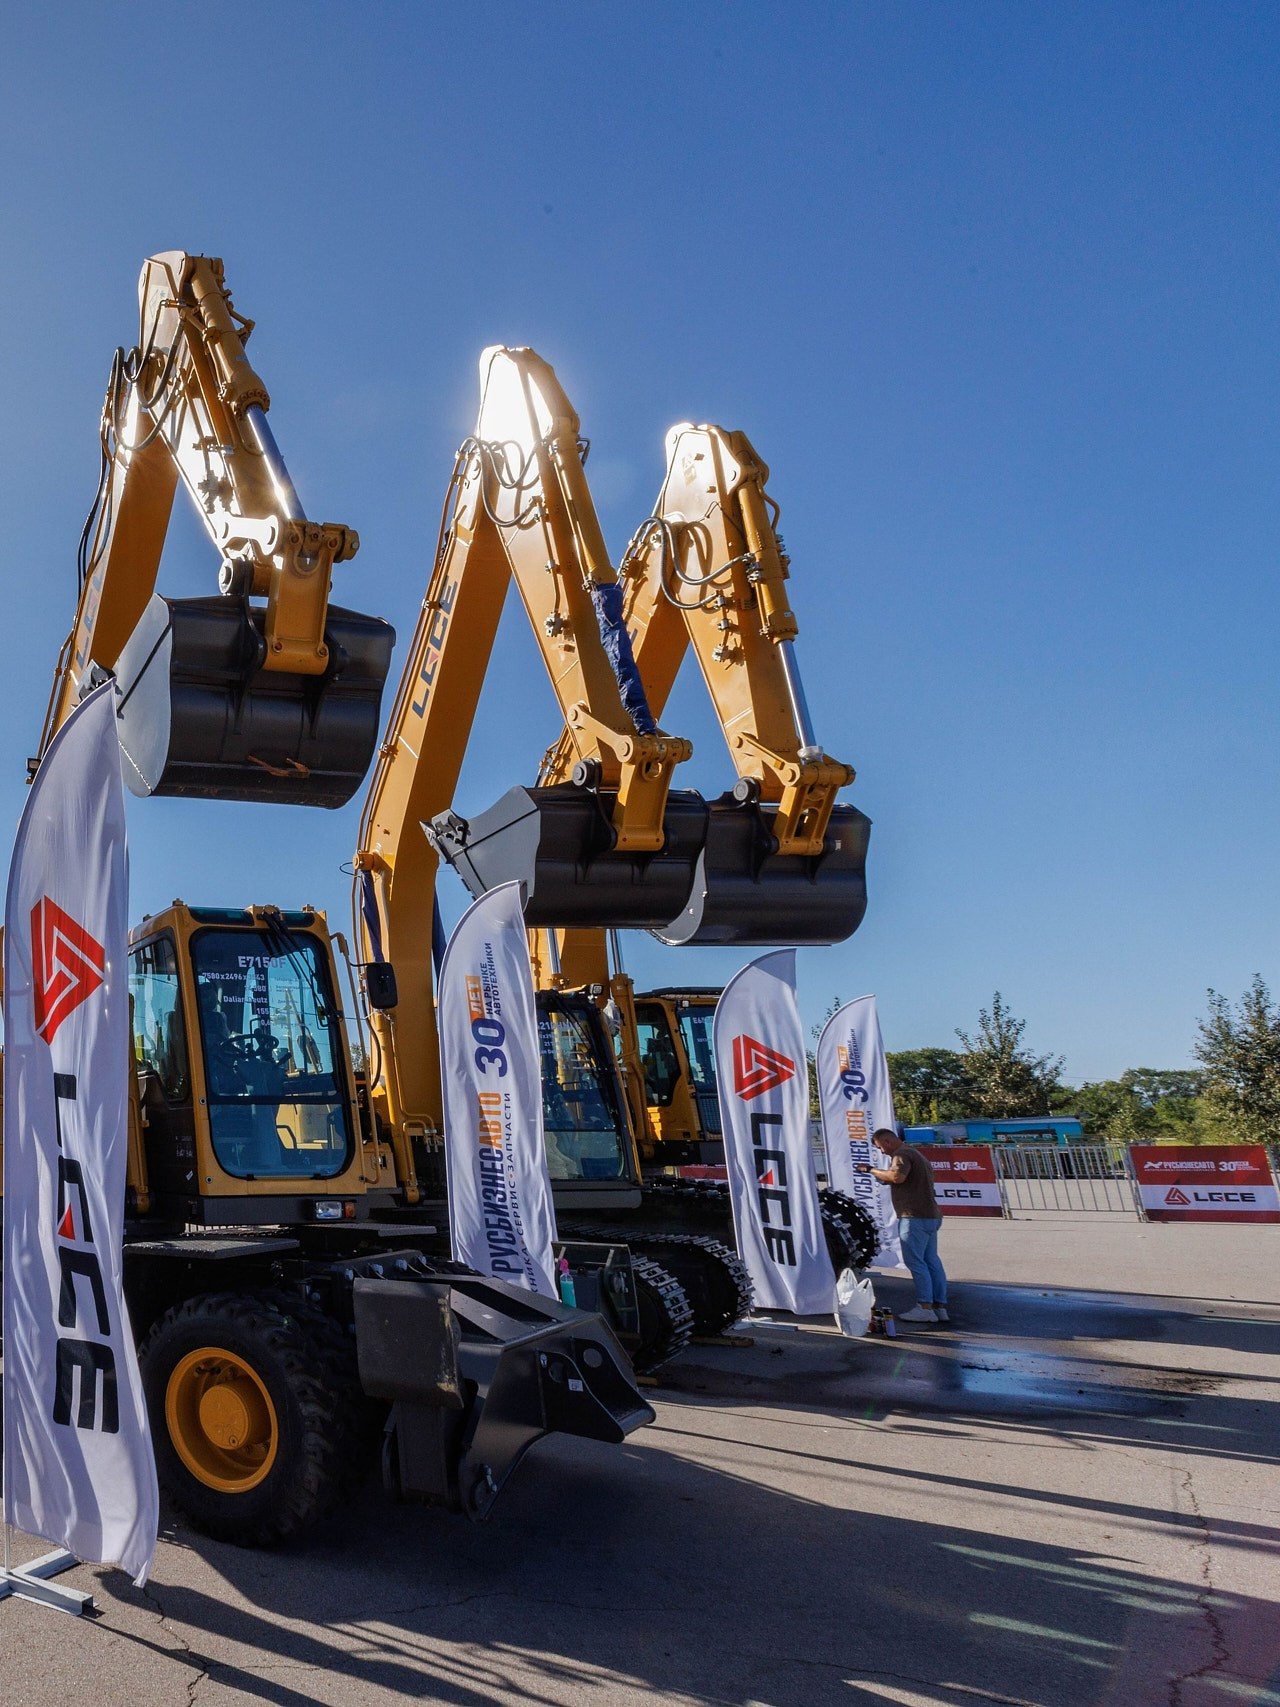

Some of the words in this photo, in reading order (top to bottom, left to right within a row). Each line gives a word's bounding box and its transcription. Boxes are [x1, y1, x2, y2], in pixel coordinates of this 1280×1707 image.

[412, 575, 458, 719] LGCE
[467, 979, 483, 1014] ЛЕТ
[480, 962, 493, 1002] РЫНКЕ
[484, 942, 501, 1016] АВТОТЕХНИКИ
[485, 1002, 494, 1015] НА
[472, 1018, 508, 1077] 30
[840, 1069, 869, 1102] 30
[503, 1093, 515, 1172] ЗАПЧАСТИ
[478, 1092, 524, 1274] РУСБИЗНЕСАВТО
[751, 1112, 797, 1266] LGCE
[953, 1161, 967, 1171] 30
[1219, 1161, 1236, 1171] 30
[1194, 1192, 1257, 1202] LGCE
[53, 1072, 120, 1434] LGCE
